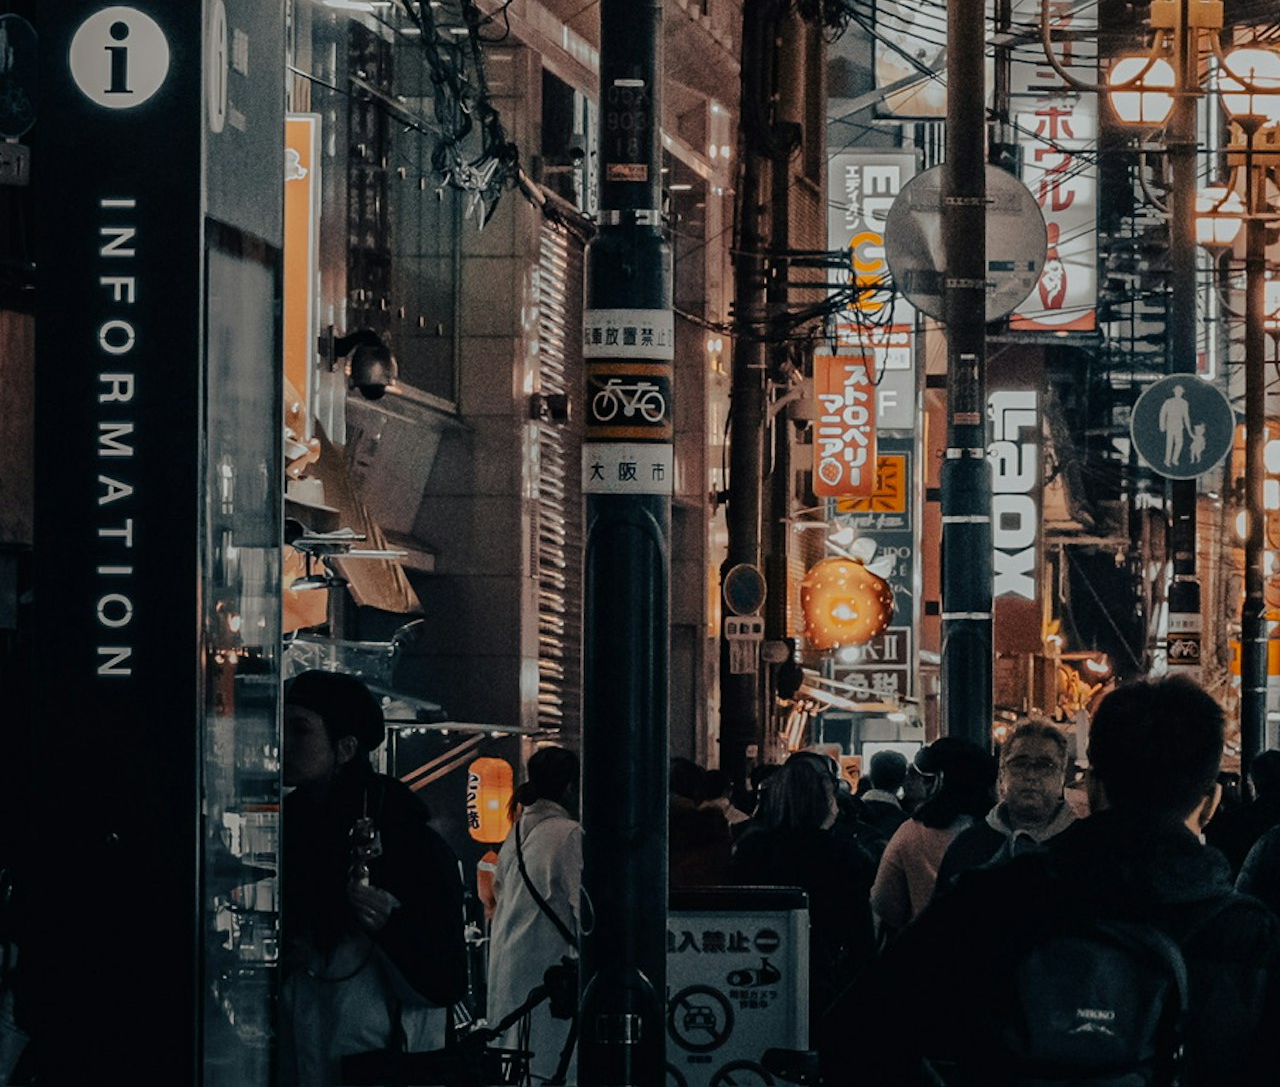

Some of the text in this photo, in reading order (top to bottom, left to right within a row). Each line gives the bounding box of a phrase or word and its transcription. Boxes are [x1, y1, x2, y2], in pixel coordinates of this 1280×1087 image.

[96, 198, 137, 678] INFORMATION
[817, 392, 846, 457] マニア
[842, 364, 872, 487] ストロベリー
[590, 462, 666, 482] 大阪市
